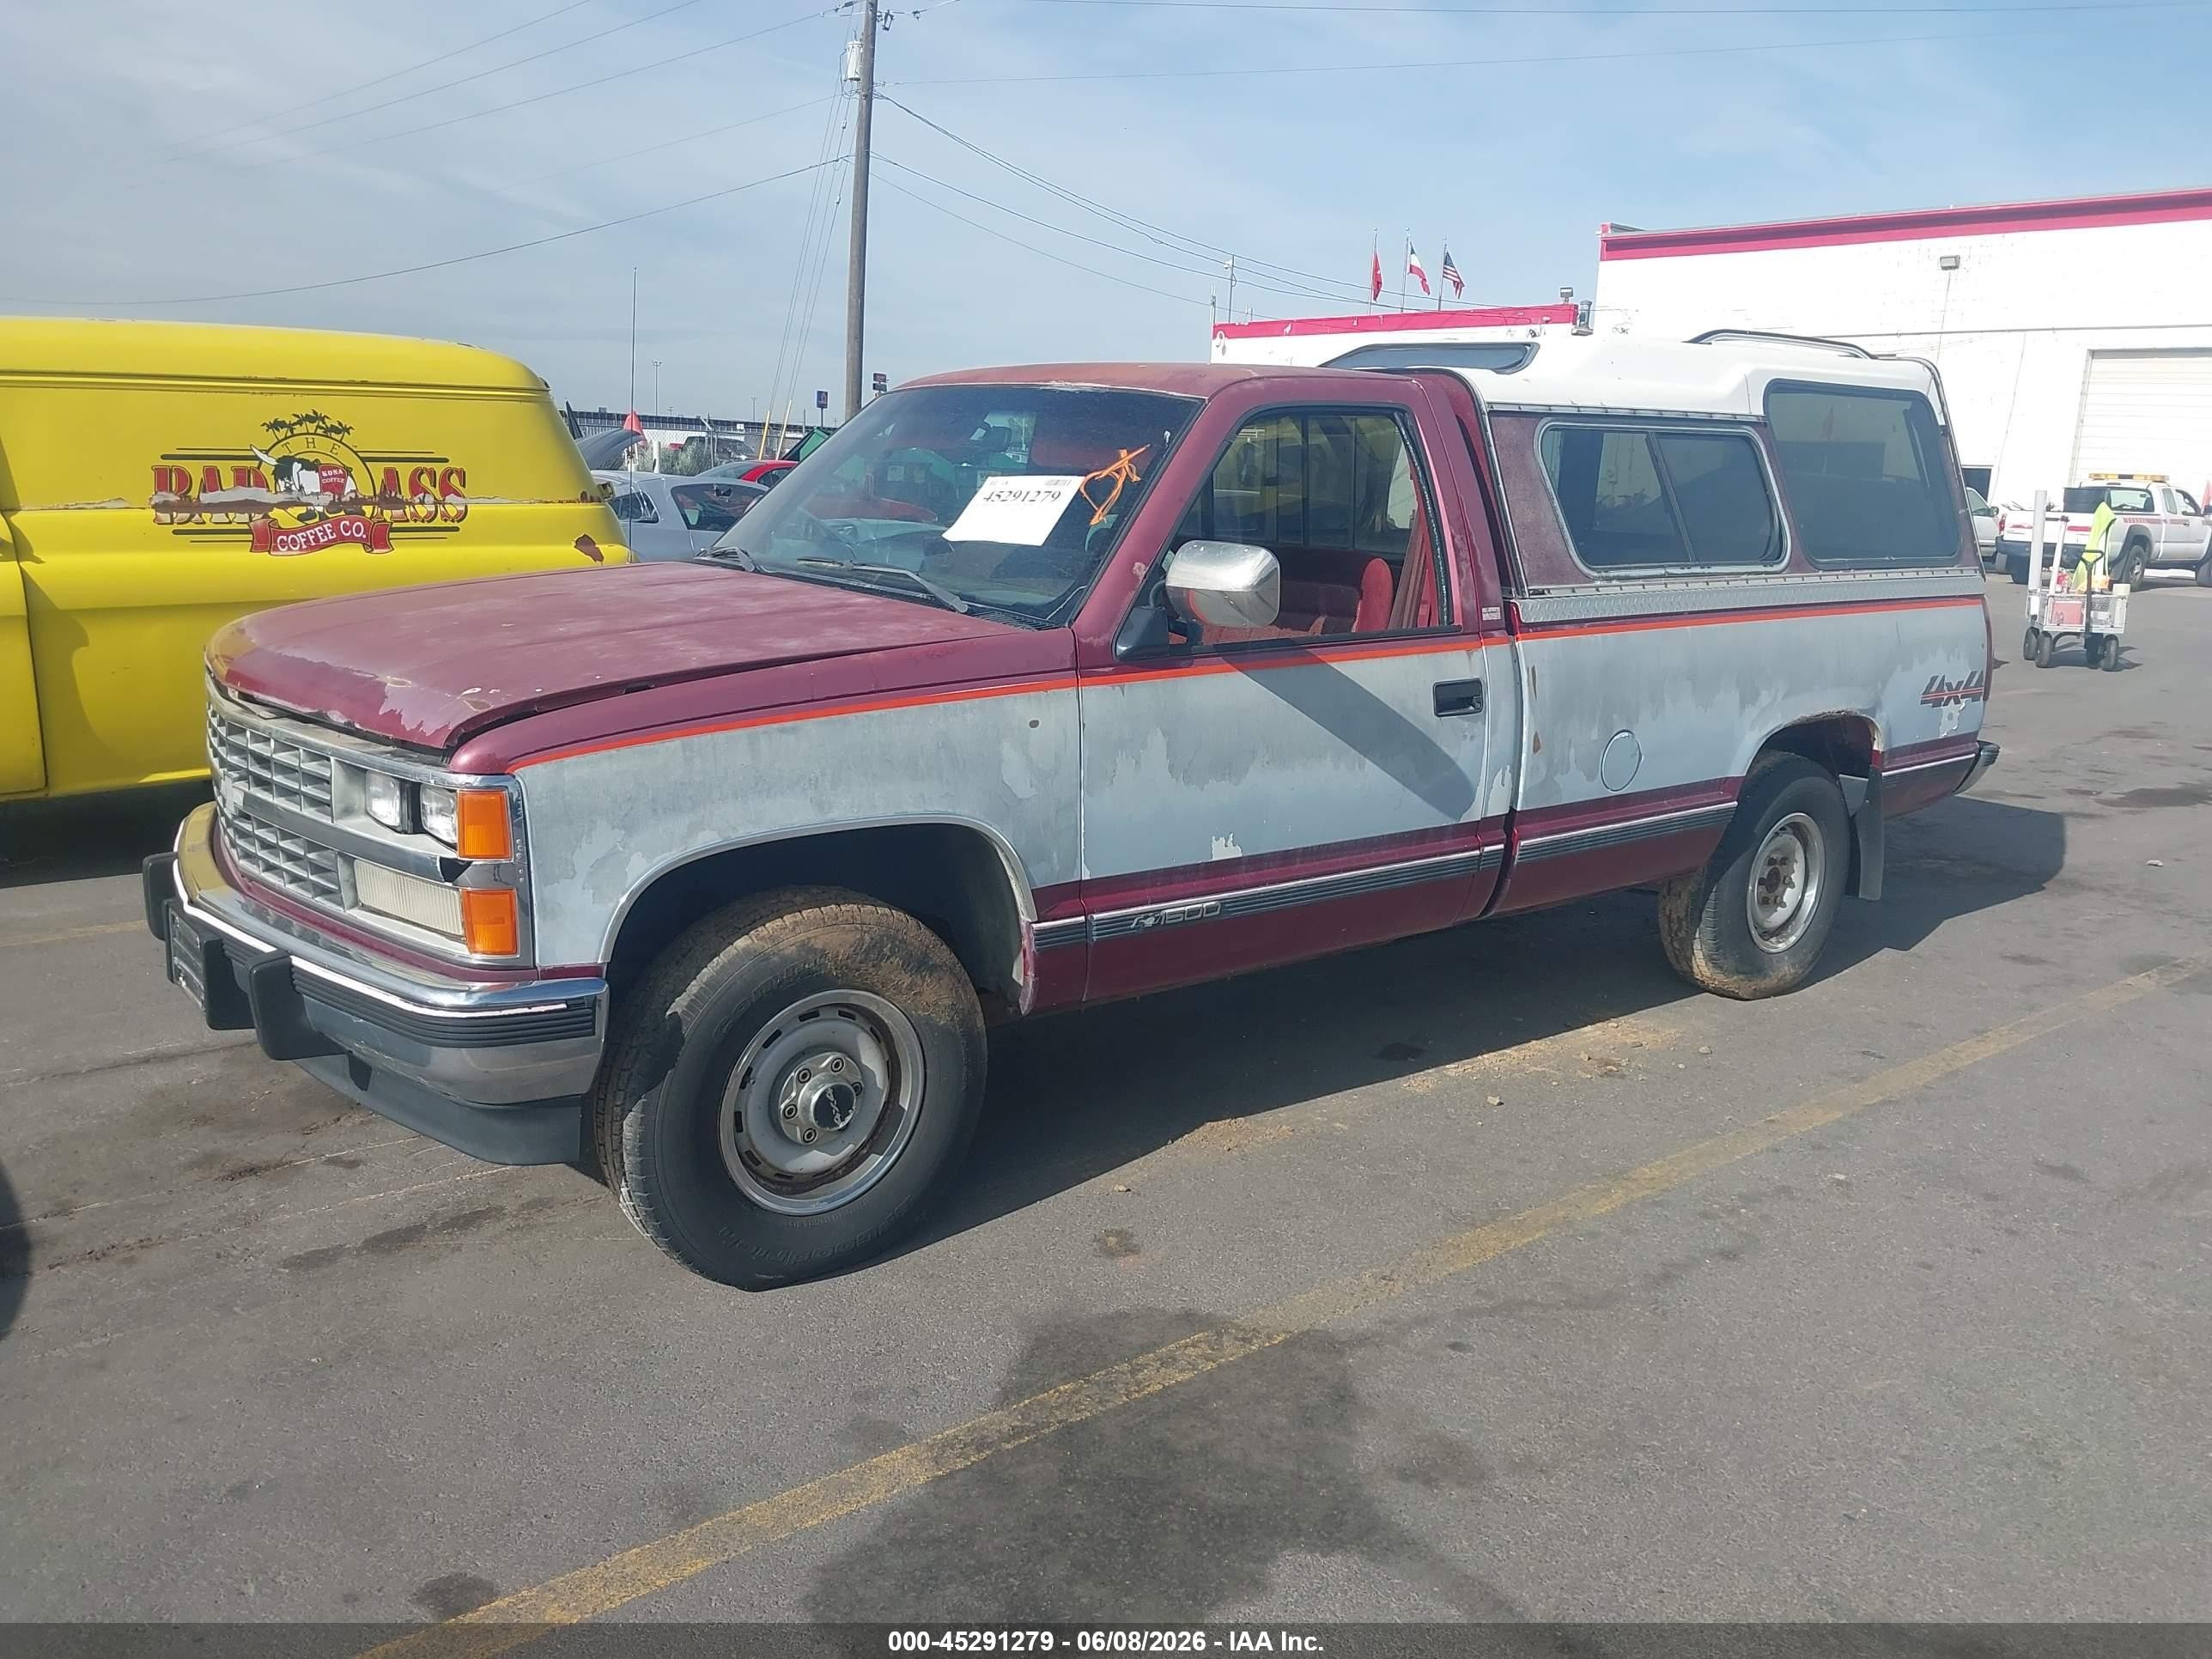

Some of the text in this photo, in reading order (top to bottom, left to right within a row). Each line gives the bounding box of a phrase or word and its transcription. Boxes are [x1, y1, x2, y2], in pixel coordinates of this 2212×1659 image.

[281, 437, 341, 456] THE
[371, 466, 469, 524] ASS
[982, 489, 1062, 503] 45291279
[276, 520, 367, 552] COFFEE CO.
